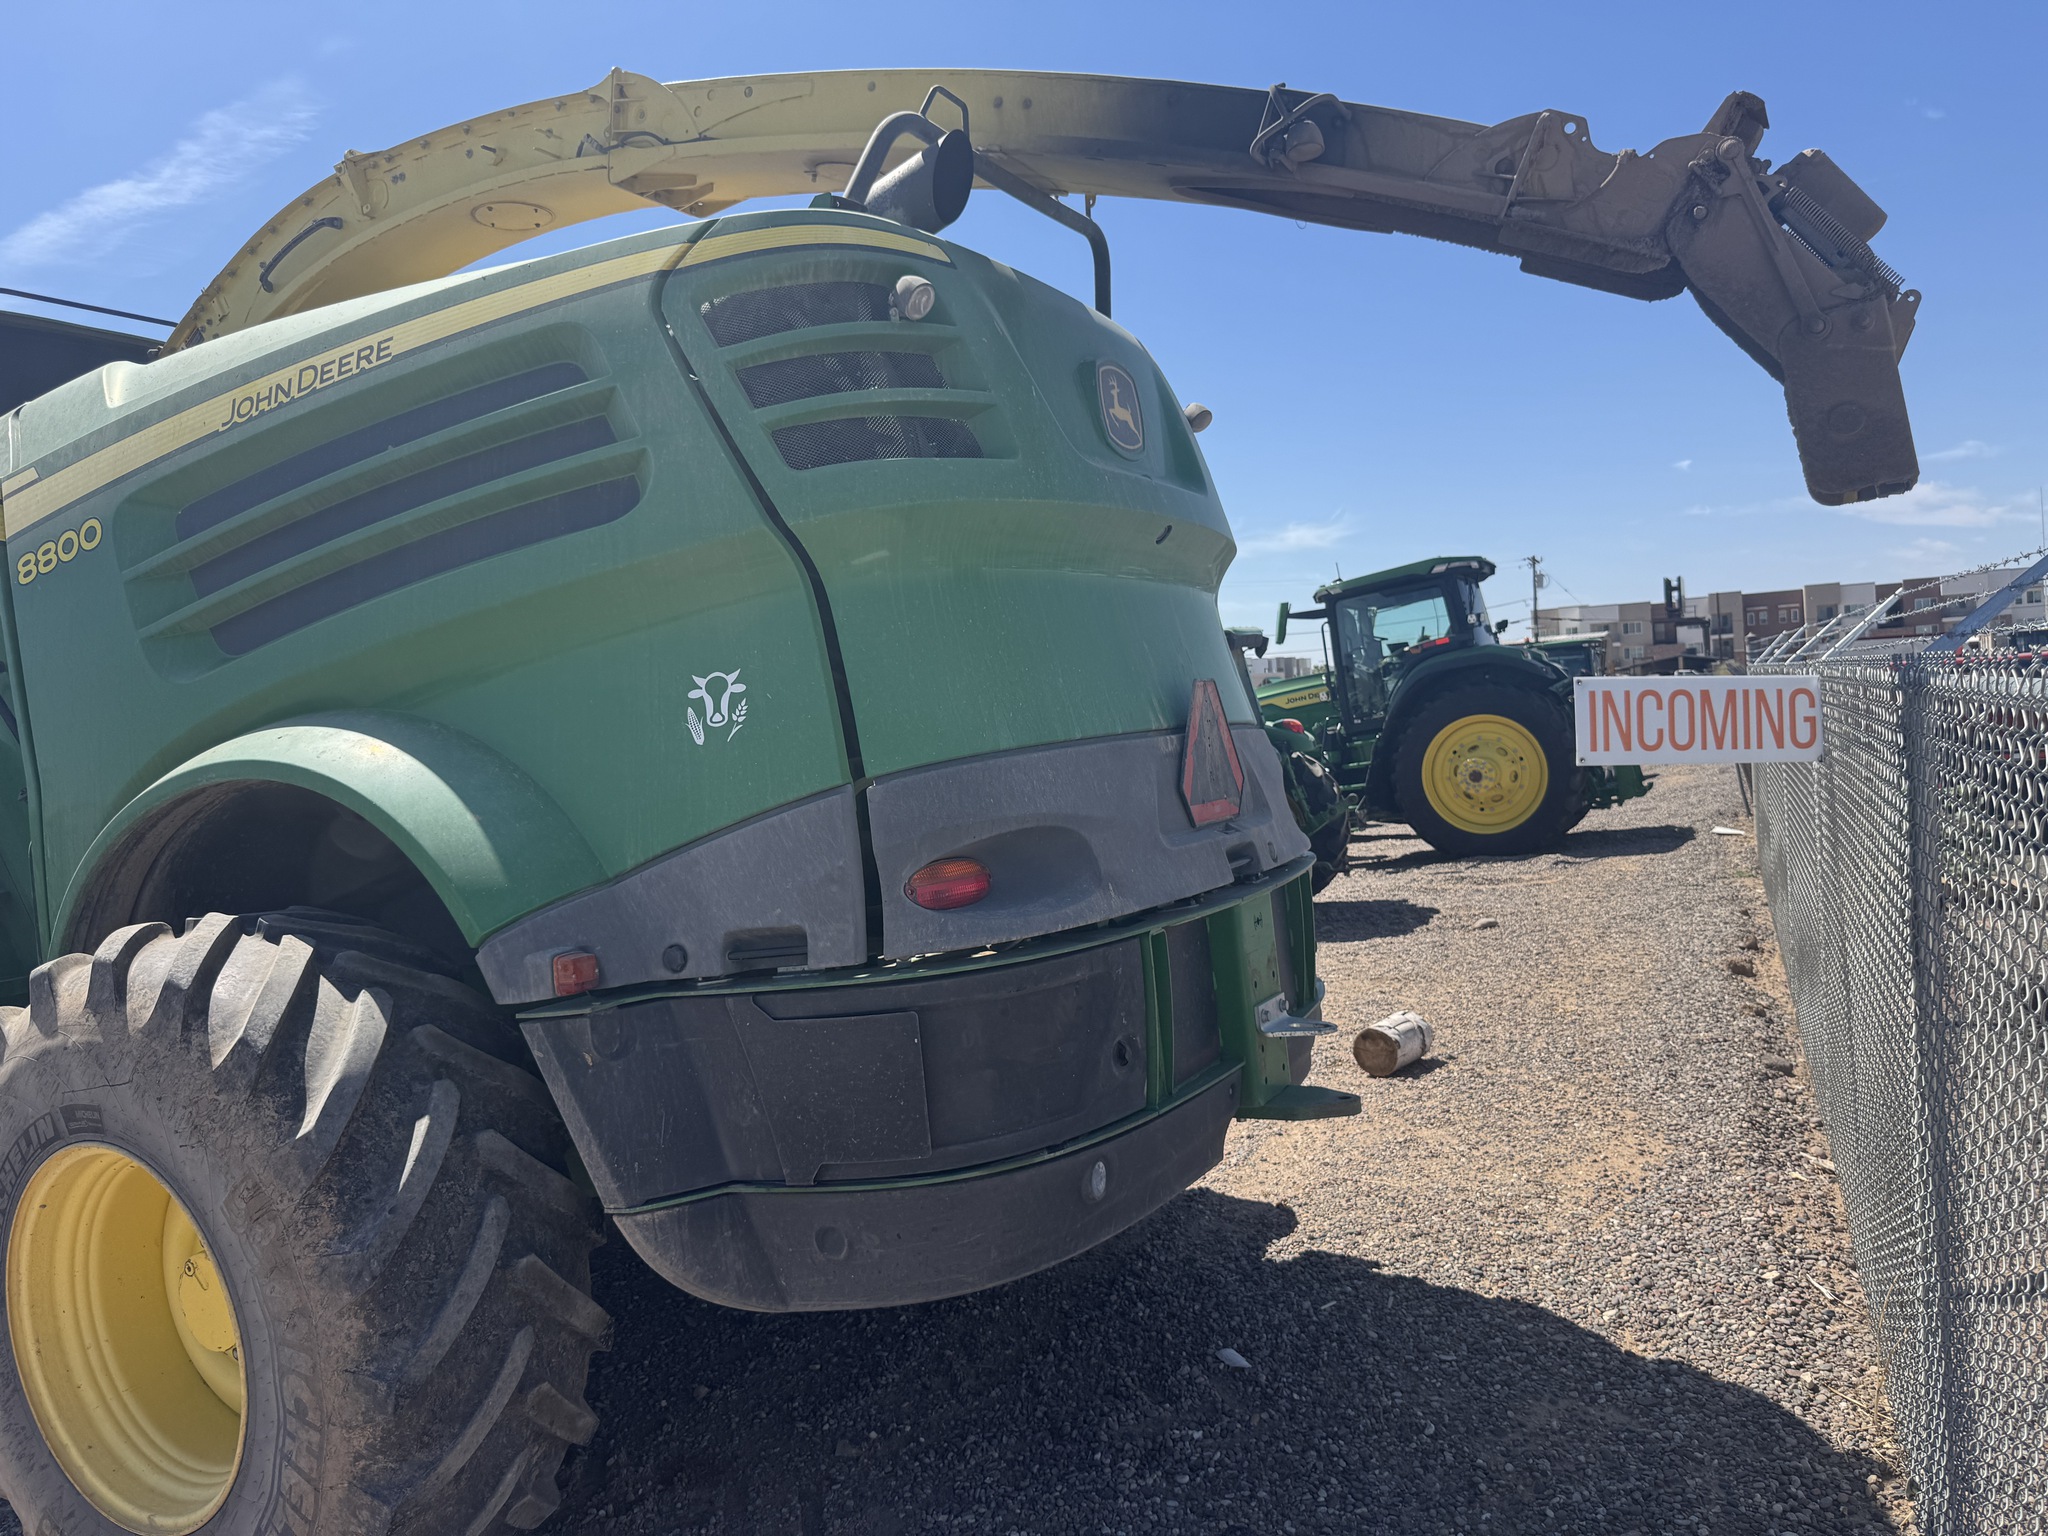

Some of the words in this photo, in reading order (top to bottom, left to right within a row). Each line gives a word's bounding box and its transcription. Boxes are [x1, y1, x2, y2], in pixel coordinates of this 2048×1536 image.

[221, 377, 293, 428] JOHN
[297, 336, 394, 395] DEERE
[17, 517, 103, 586] 8800
[1285, 695, 1307, 704] JOHN
[1588, 687, 1817, 752] INCOMING
